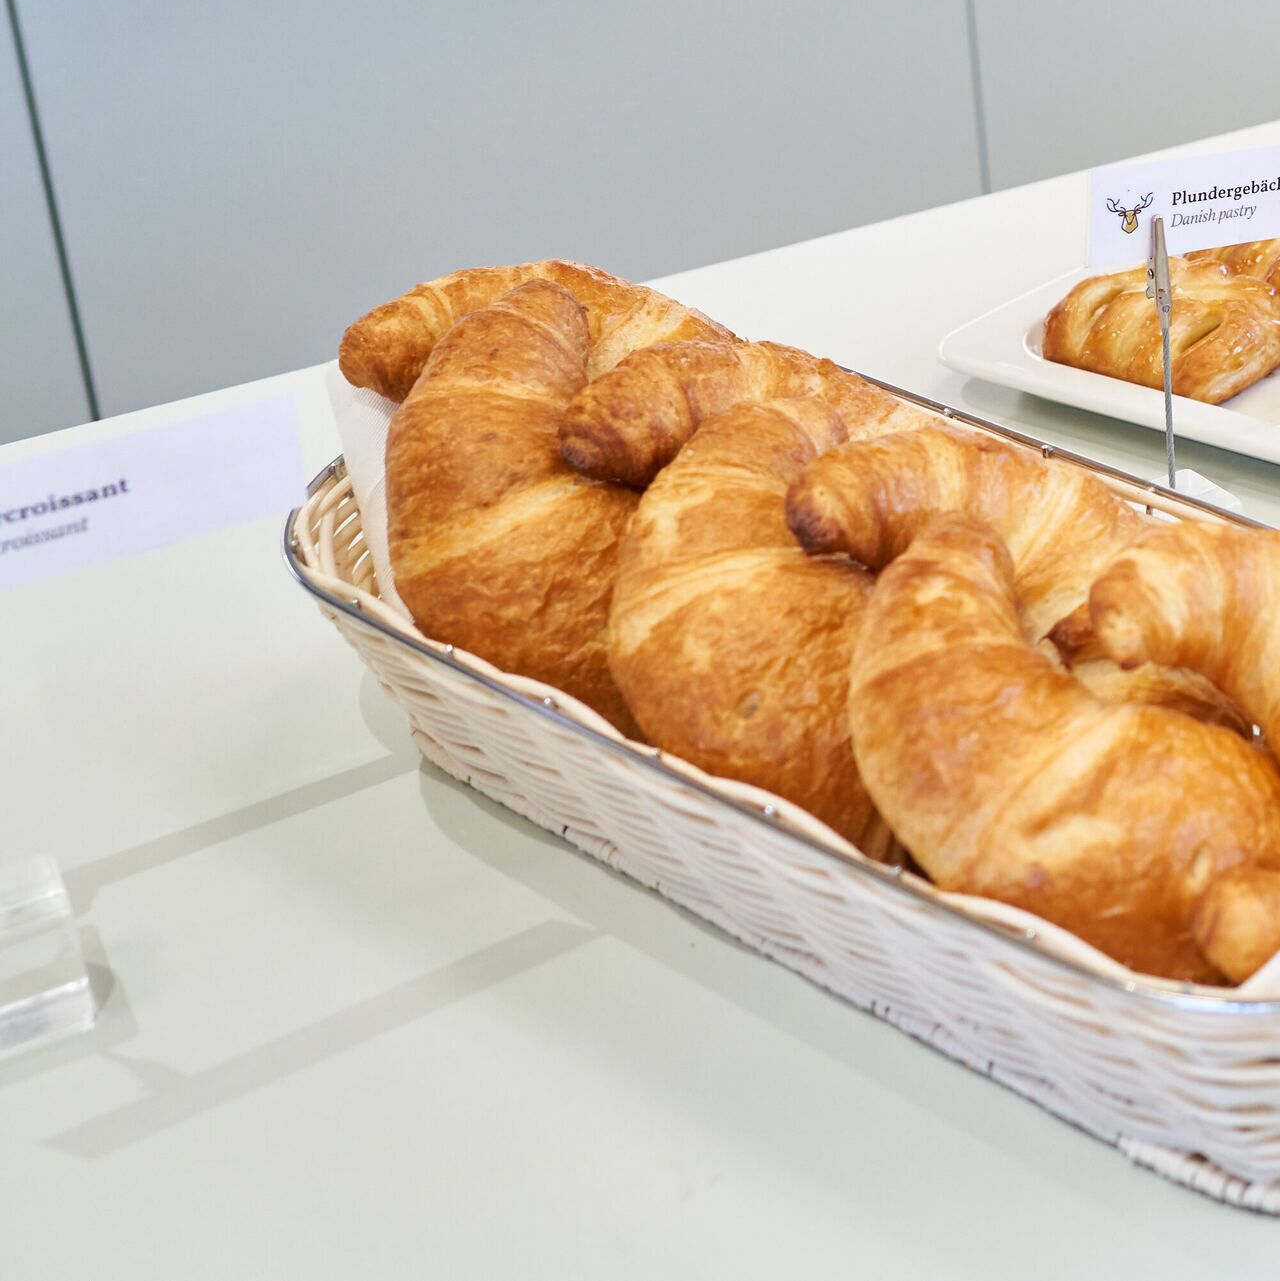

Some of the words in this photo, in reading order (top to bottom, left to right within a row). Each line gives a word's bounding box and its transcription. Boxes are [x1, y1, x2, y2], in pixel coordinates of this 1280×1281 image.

[1170, 208, 1216, 228] Danish
[1217, 205, 1257, 225] pastry
[0, 516, 89, 555] roissant
